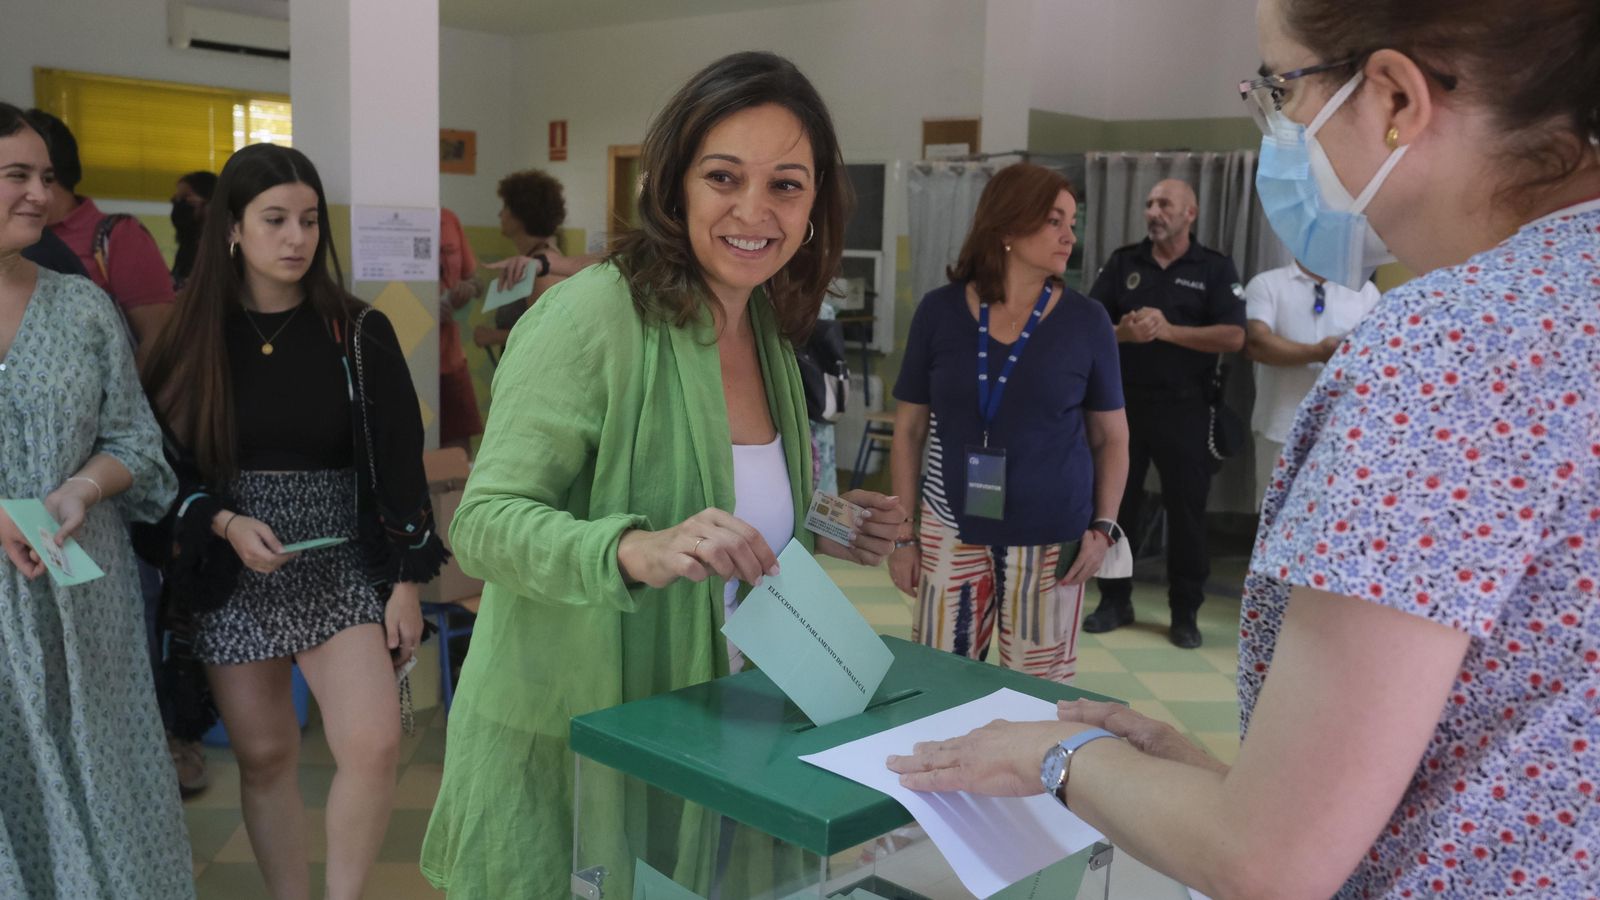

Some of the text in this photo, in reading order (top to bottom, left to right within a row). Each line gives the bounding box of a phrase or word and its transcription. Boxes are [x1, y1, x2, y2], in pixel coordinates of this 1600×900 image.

[767, 585, 800, 618] ELECCIONES
[799, 616, 807, 626] AL
[805, 623, 837, 660] PARLAMENTO
[835, 657, 844, 667] DE
